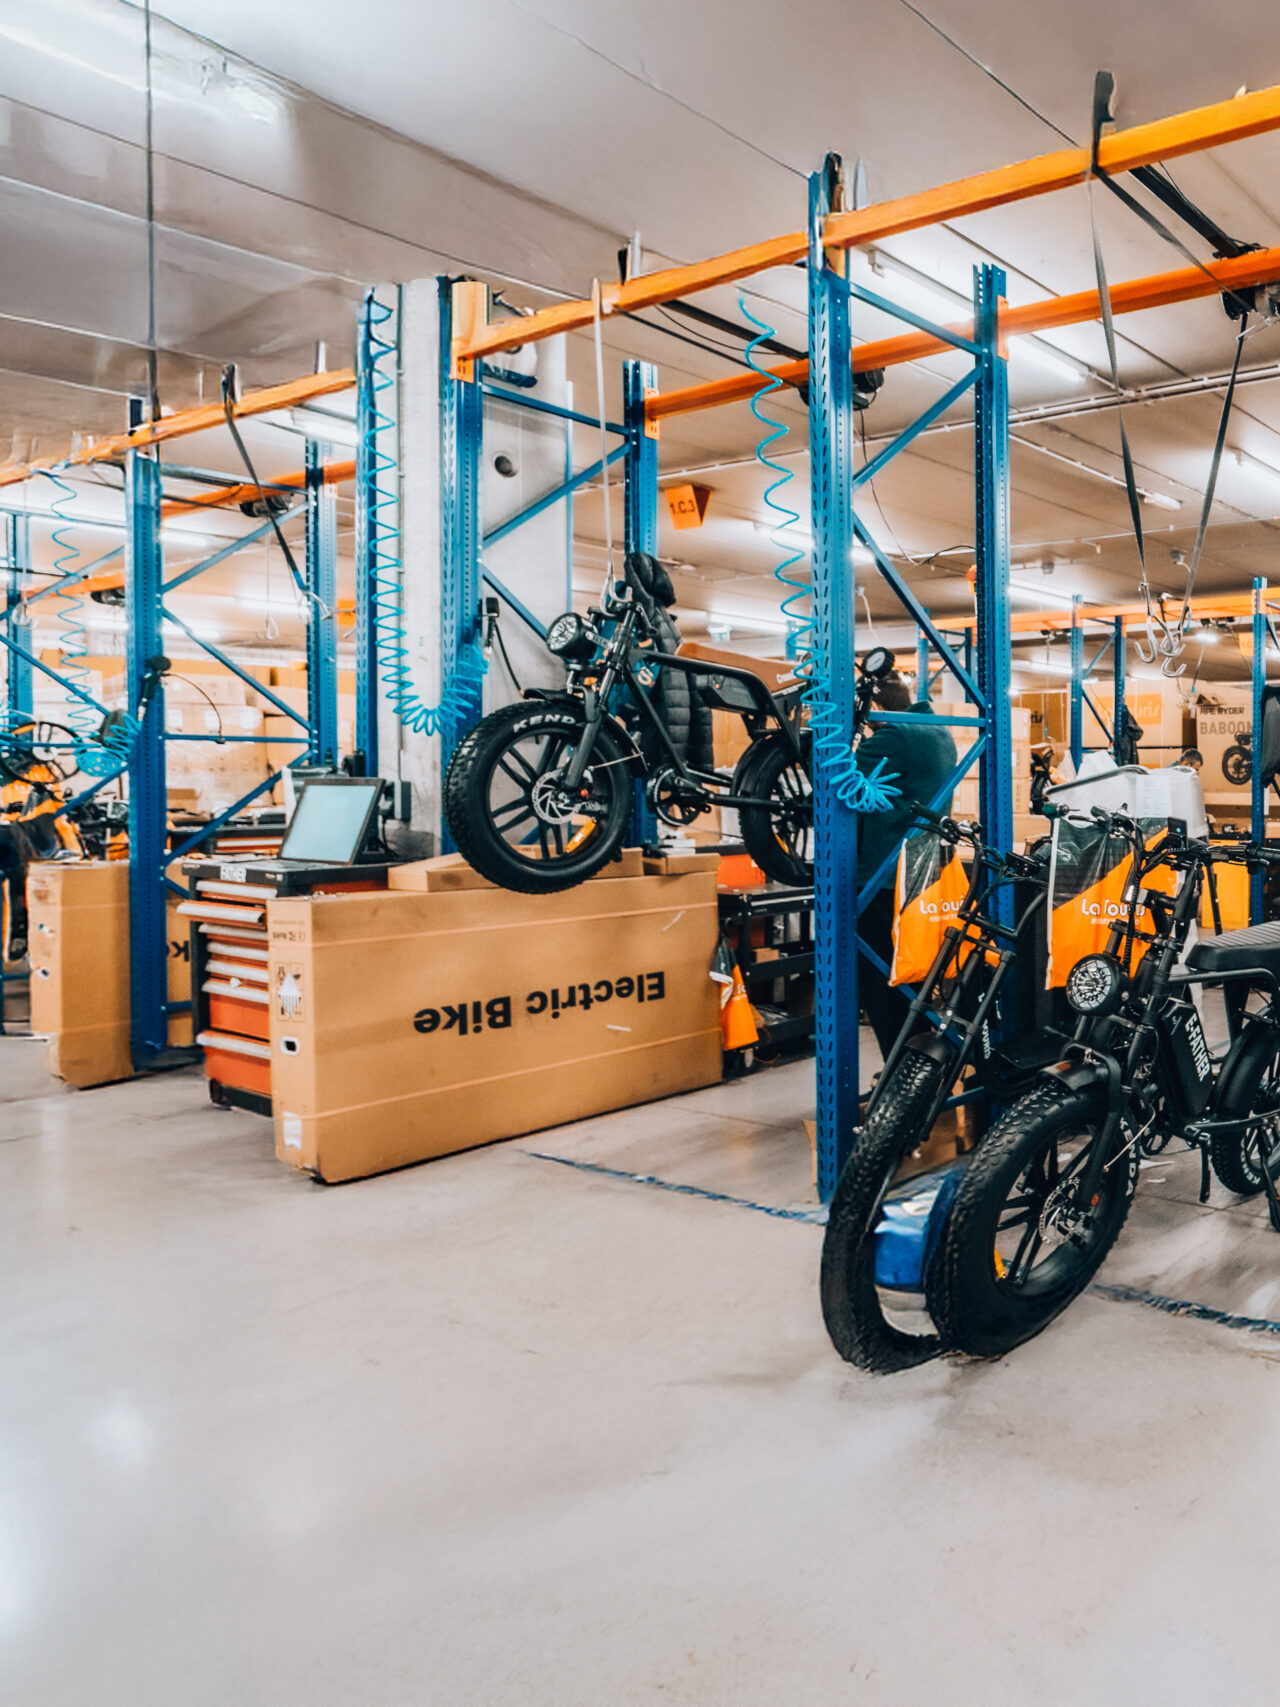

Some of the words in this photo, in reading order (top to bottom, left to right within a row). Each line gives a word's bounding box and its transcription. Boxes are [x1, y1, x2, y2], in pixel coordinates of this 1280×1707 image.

[669, 499, 697, 515] 1.C.3
[513, 713, 584, 734] KEND
[1081, 898, 1101, 916] La
[525, 971, 666, 1020] Electric
[412, 996, 512, 1036] Bike
[1185, 1011, 1211, 1082] E-FATHER
[1119, 1116, 1137, 1197] KENDA
